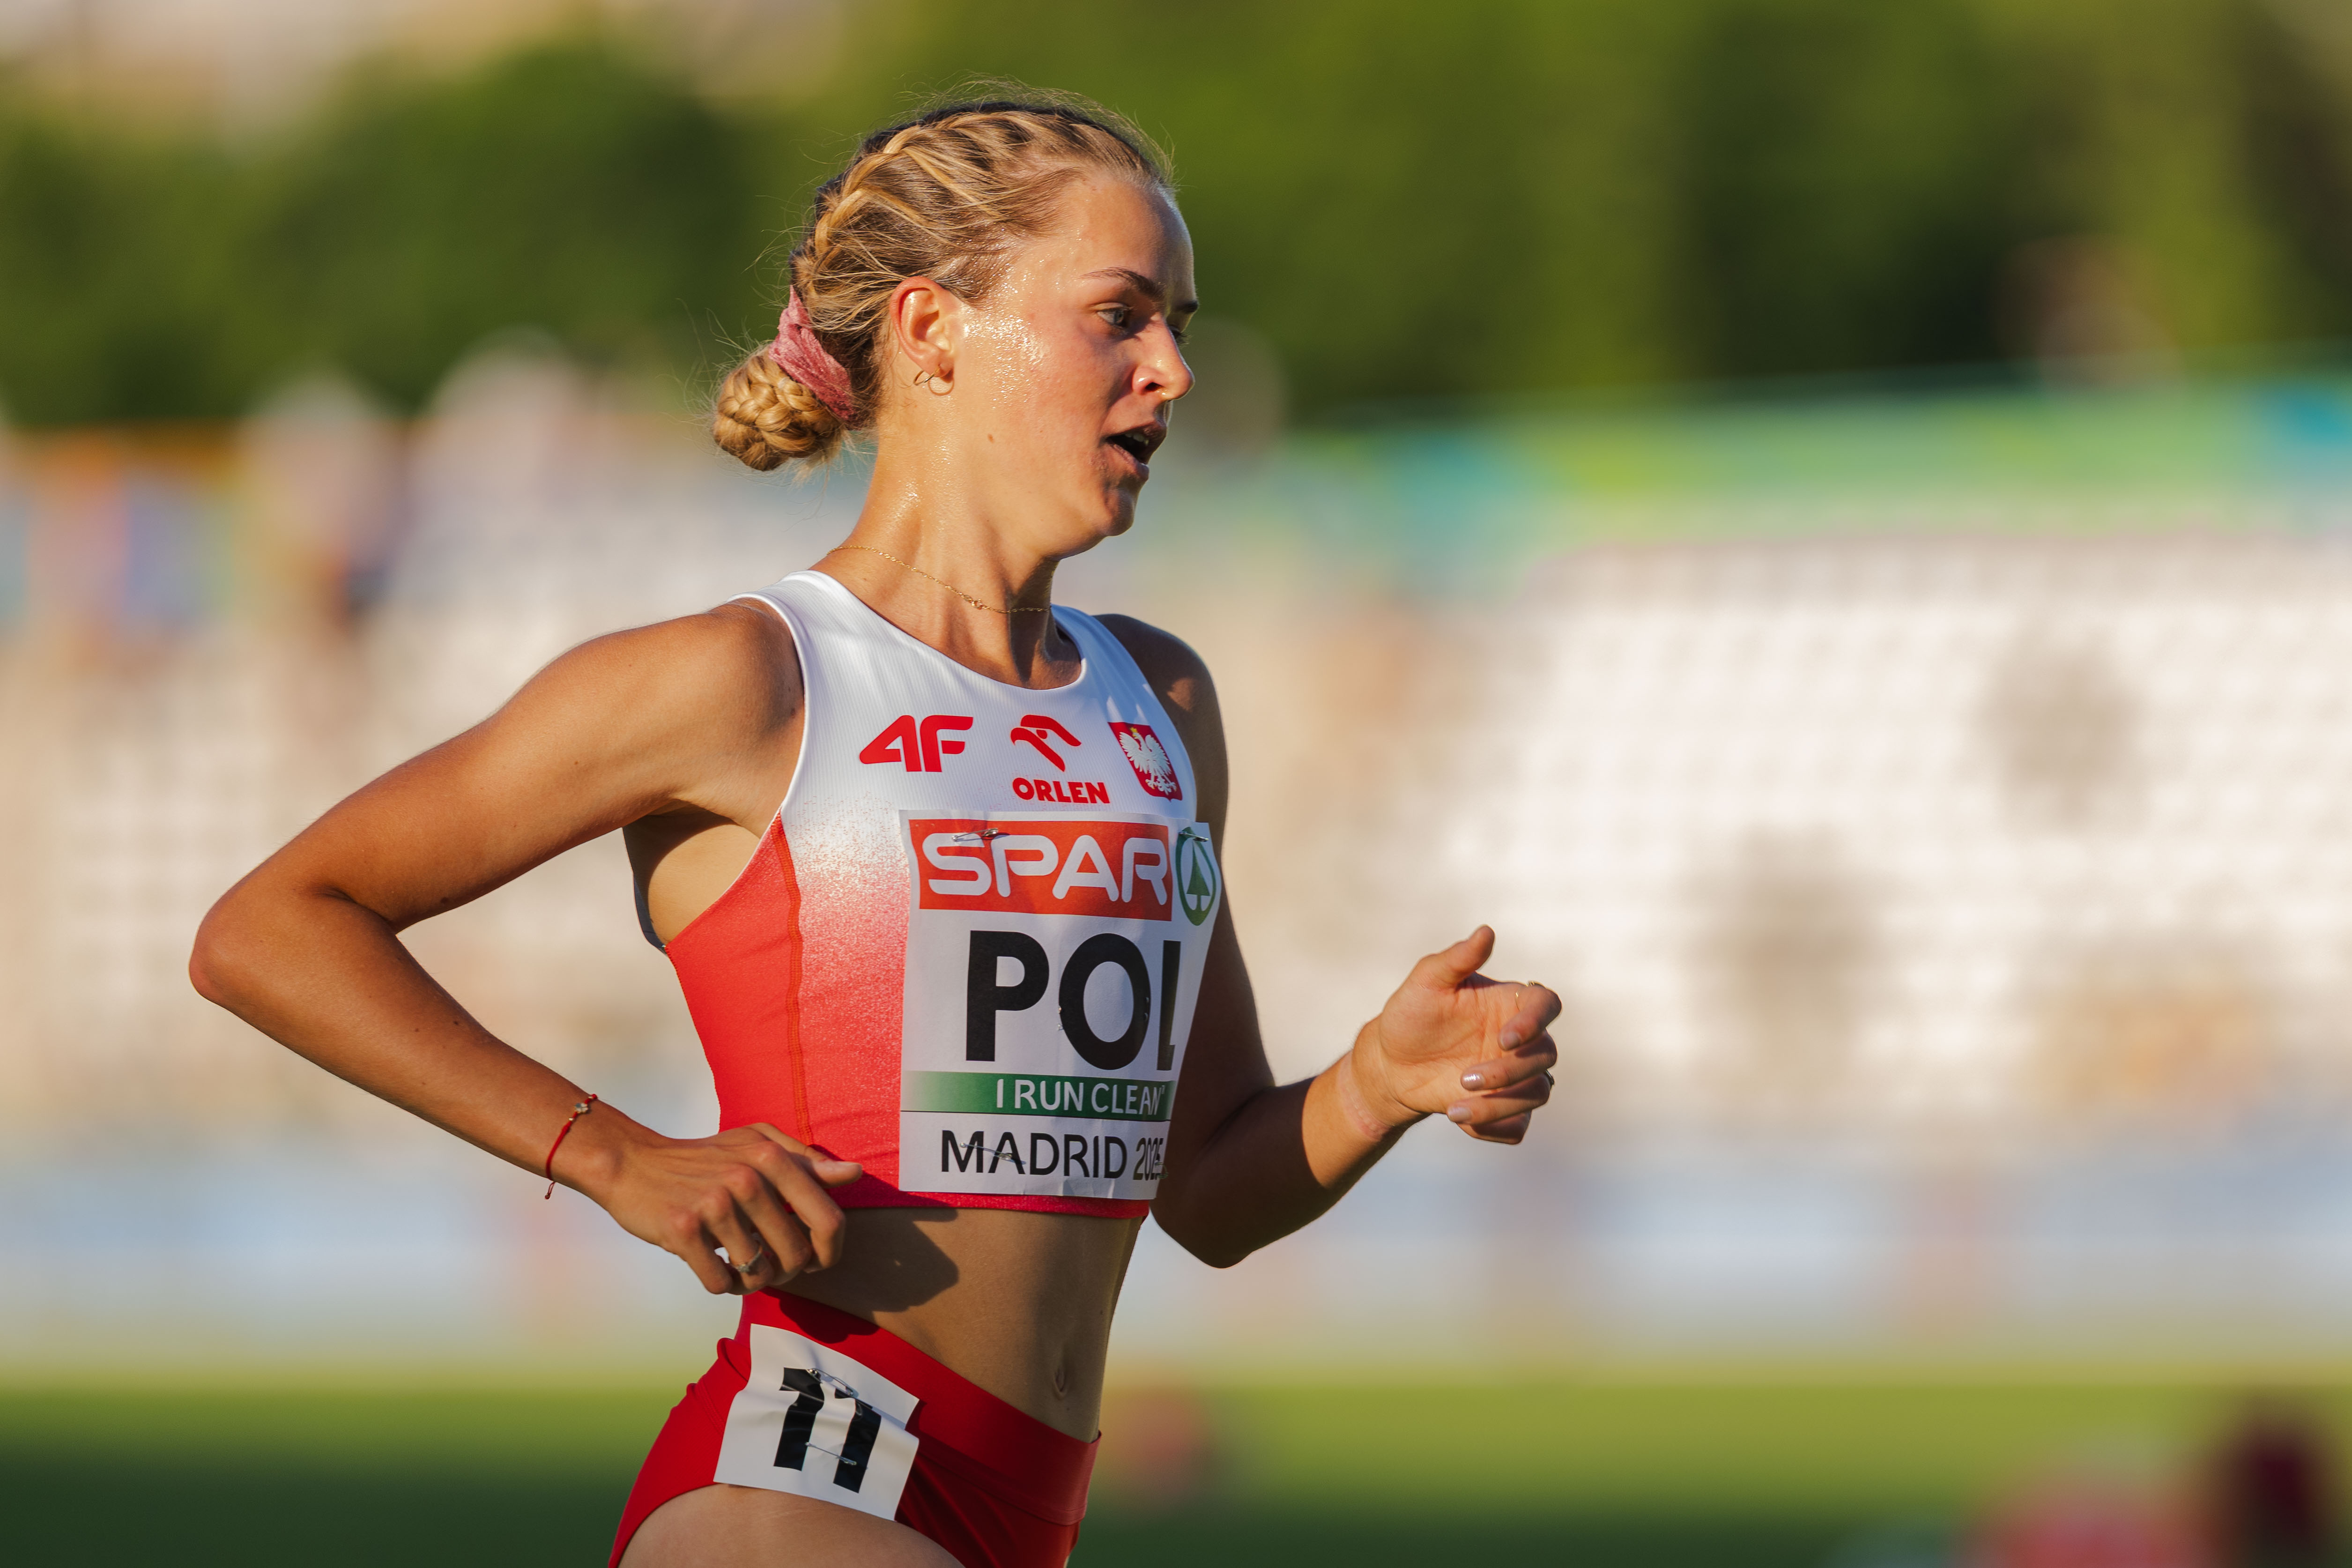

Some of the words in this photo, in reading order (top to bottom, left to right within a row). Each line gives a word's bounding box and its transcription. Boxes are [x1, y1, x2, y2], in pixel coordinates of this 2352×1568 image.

[859, 714, 973, 773] 4F
[1012, 777, 1110, 804] ORLEN
[922, 832, 1168, 906] SPAR
[965, 930, 1181, 1071] POL
[996, 1078, 1004, 1108] I
[1014, 1079, 1084, 1111] RUN
[941, 1130, 1128, 1179] MADRID
[773, 1367, 882, 1494] 11
